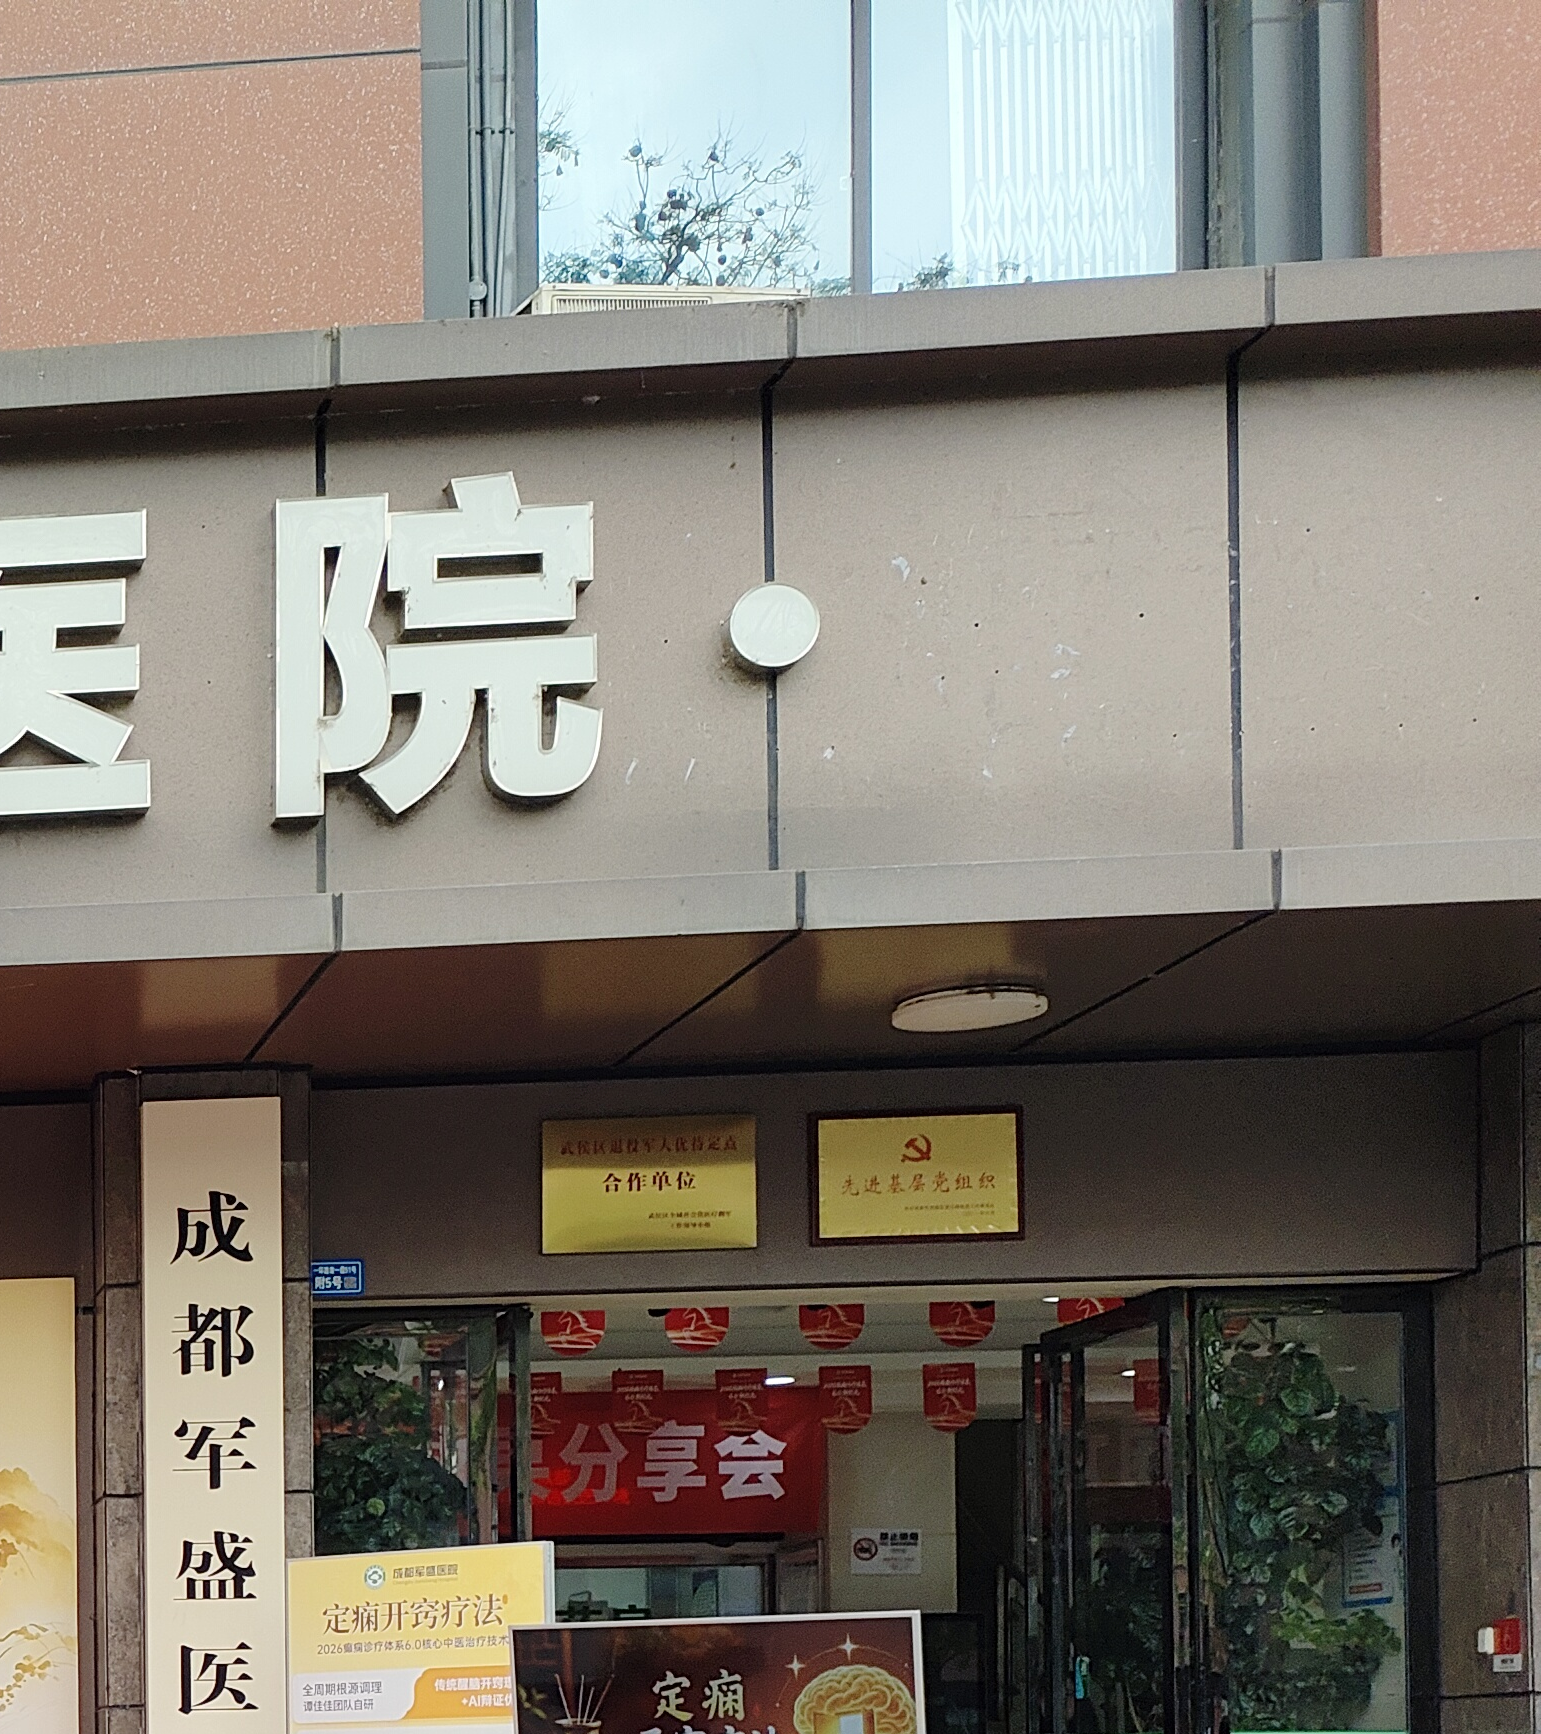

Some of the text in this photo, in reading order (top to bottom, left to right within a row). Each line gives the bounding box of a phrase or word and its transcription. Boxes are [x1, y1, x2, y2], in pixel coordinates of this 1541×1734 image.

[602, 1171, 696, 1193] 合作单位
[842, 1171, 995, 1196] 先进基层党组织
[322, 1593, 503, 1635] 定痫开窍疗法
[302, 1681, 382, 1697] 全周期根源调理
[652, 1669, 745, 1721] 定痫
[303, 1699, 374, 1712] 谭佳佳团队自研
